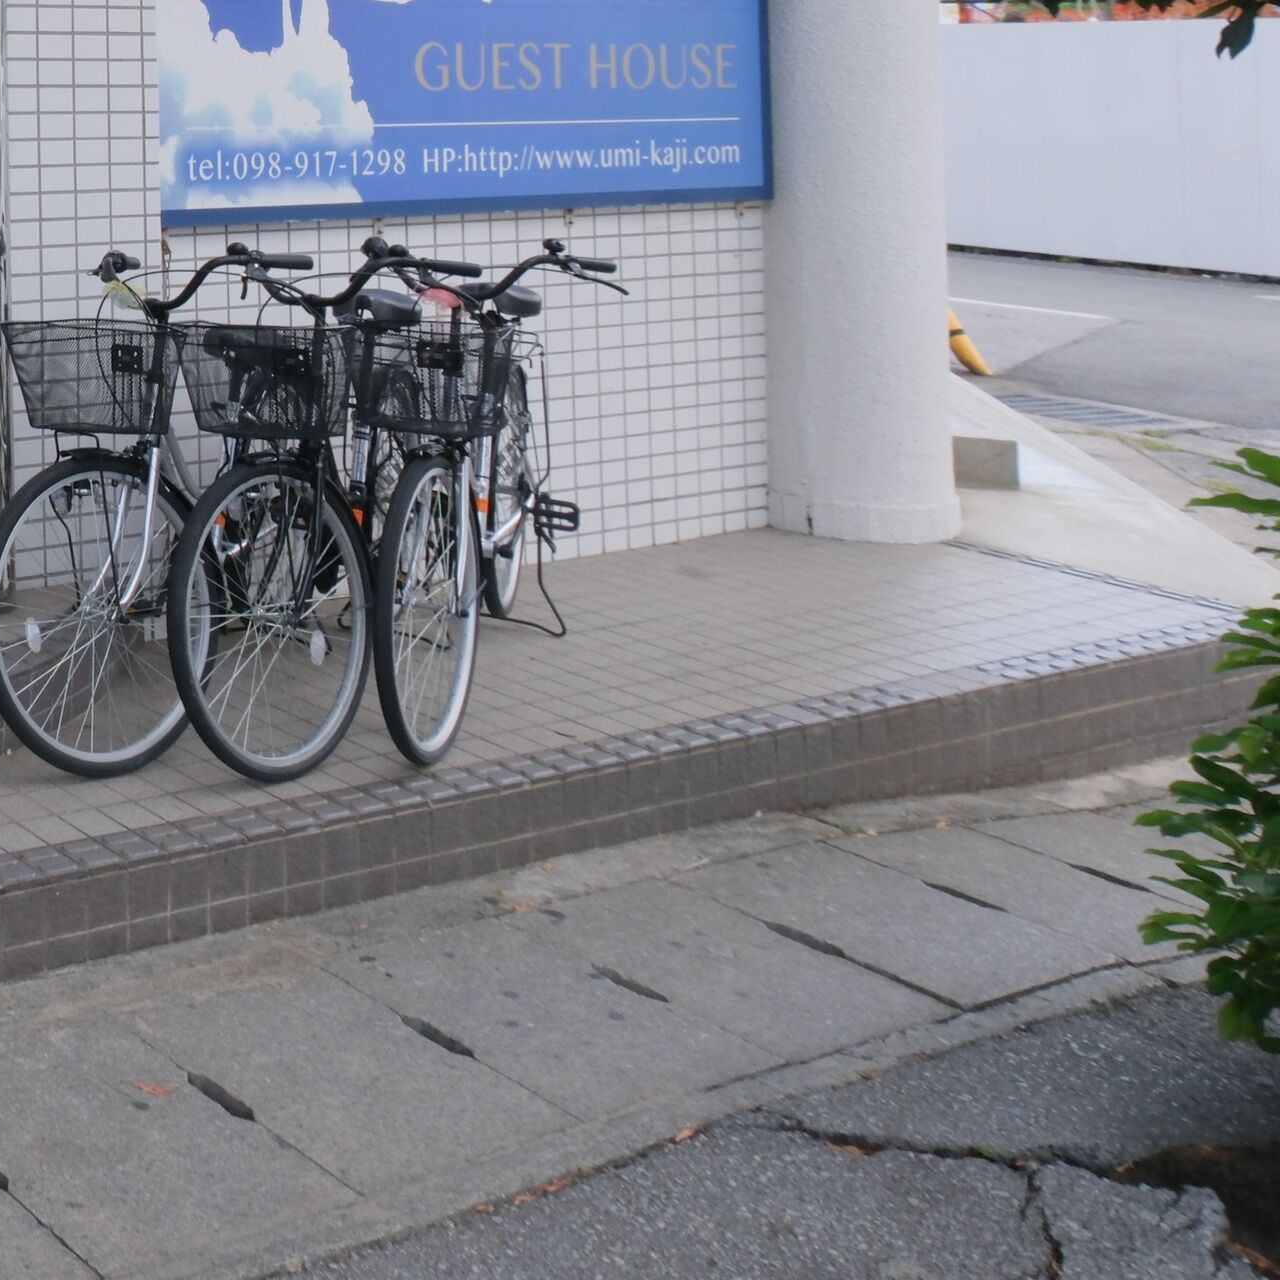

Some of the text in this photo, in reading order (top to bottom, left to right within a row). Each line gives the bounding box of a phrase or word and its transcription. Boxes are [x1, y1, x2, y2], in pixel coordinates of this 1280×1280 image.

[413, 40, 739, 92] GUEST HOUSE
[187, 140, 741, 182] tel:098-917-1298 HP:http://www.umi-kaji.com
